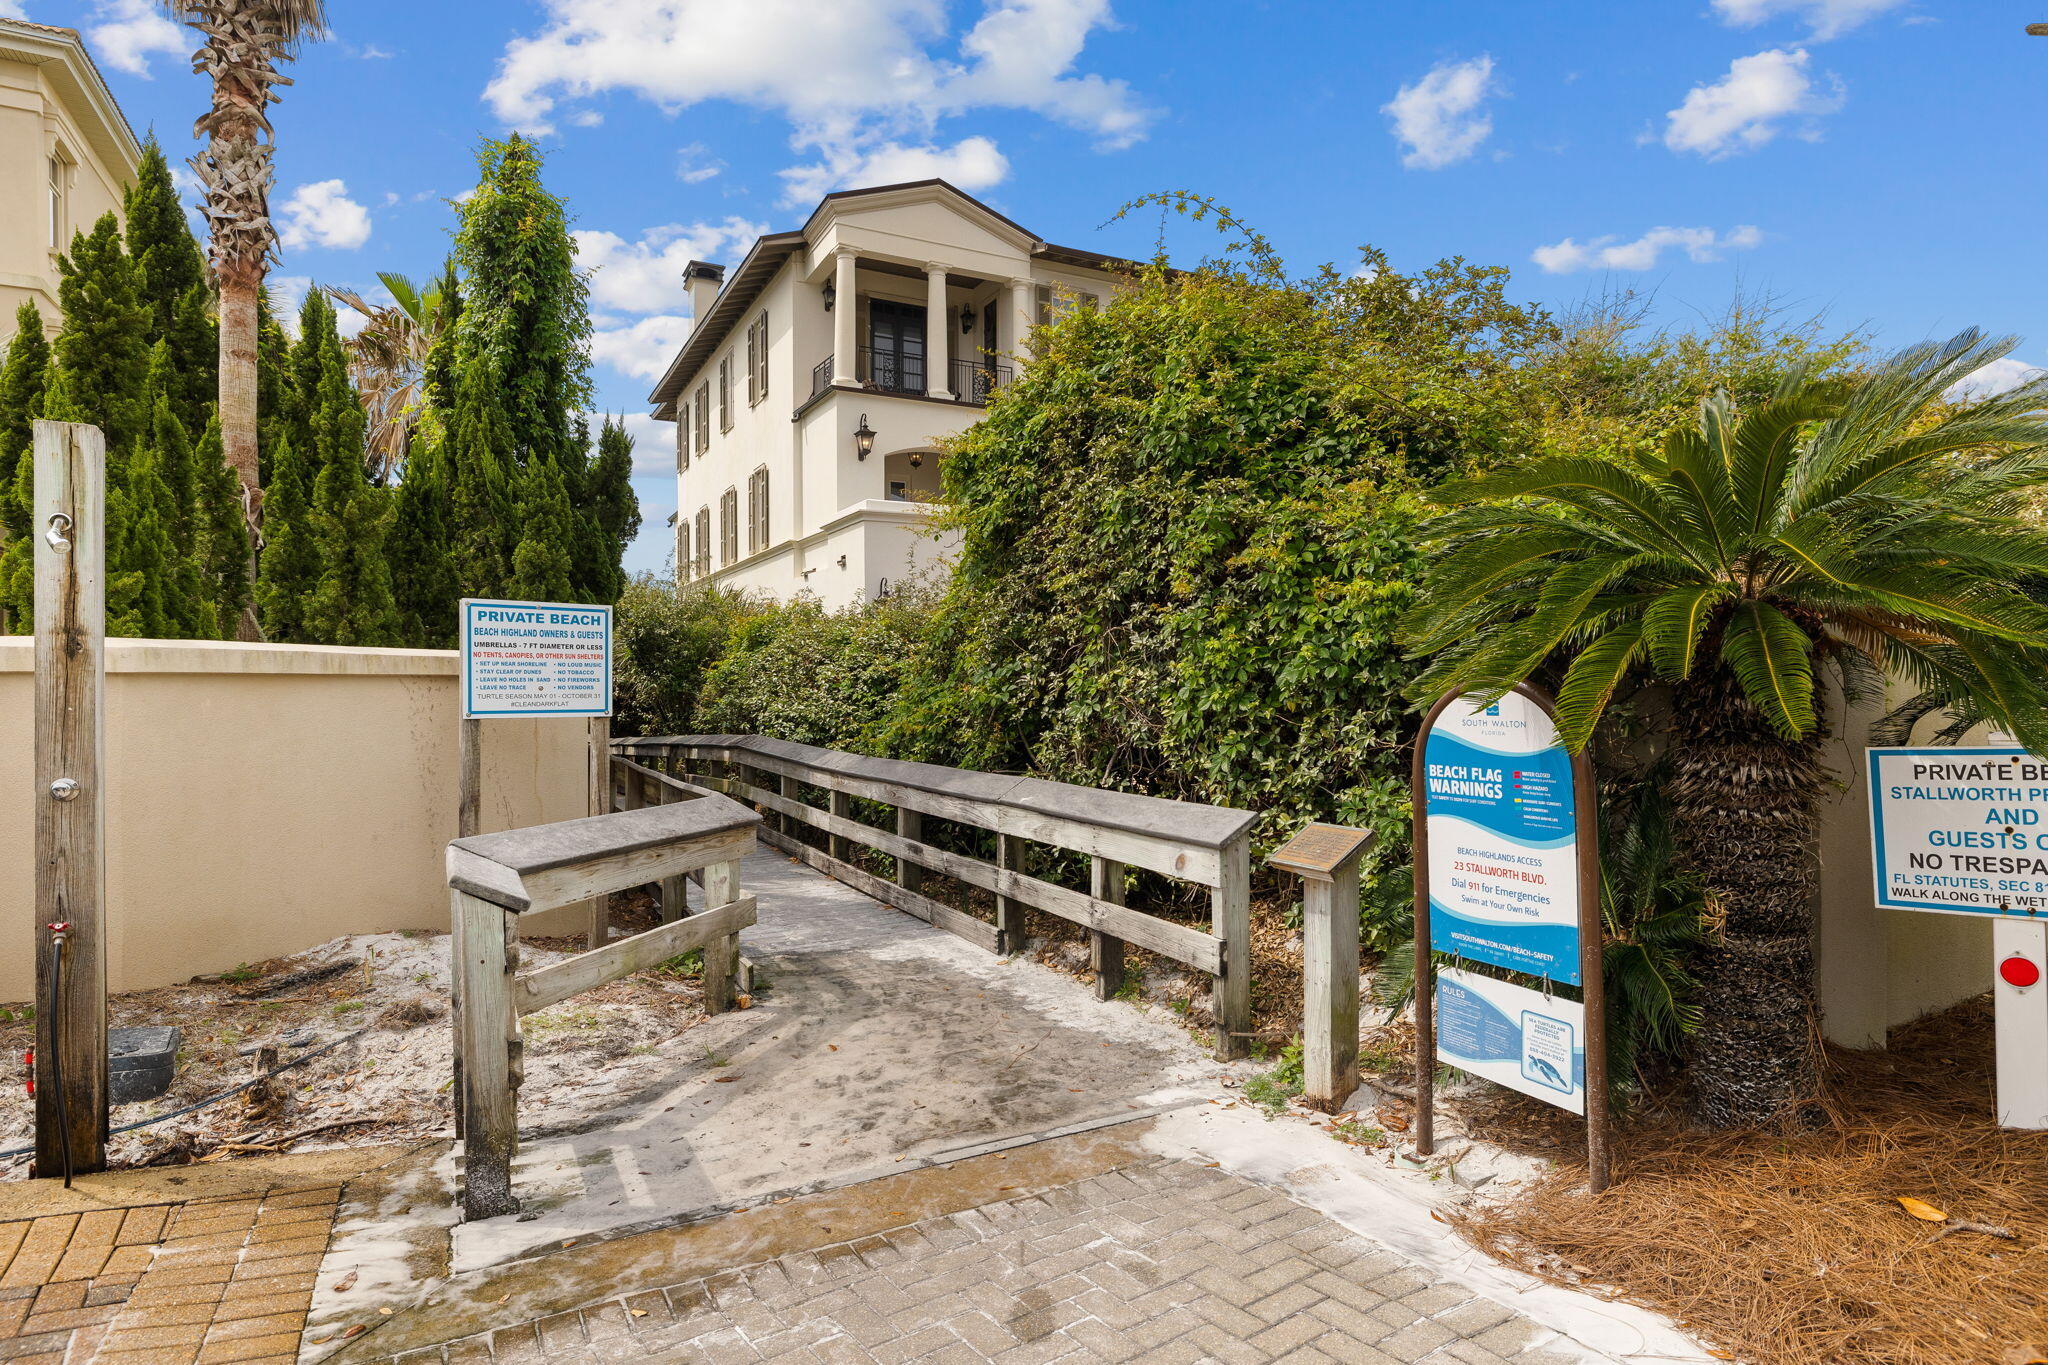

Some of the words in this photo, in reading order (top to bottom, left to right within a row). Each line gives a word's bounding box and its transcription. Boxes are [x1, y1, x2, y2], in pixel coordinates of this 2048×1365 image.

[477, 610, 545, 623] PRIVATE
[550, 614, 601, 626] BEACH
[473, 627, 499, 636] BEACH
[500, 628, 538, 638] HIGHLAND
[539, 629, 569, 639] OWNERS
[570, 630, 575, 639] &
[577, 631, 604, 639] GUESTS
[473, 641, 518, 649] UMBRELLAS
[1461, 719, 1488, 727] SOUTH
[1491, 720, 1527, 728] WALTON
[1429, 764, 1468, 780] BEACH
[1471, 767, 1503, 782] FLAG
[1913, 764, 2014, 781] PRIVATE
[1429, 778, 1503, 799] WARNINGS
[1890, 786, 2022, 801] STALLWORTH
[1985, 808, 2039, 826] AND
[1928, 830, 2028, 850] GUESTS
[1457, 846, 1478, 857] BEACH
[1478, 850, 1516, 863] HIGHLANDS
[1516, 856, 1543, 867] ACCESS
[1909, 852, 1943, 870] NO
[1454, 861, 1464, 871] 23
[1465, 862, 1519, 880] STALLWORTH
[1521, 871, 1547, 886] BLVD.
[1894, 873, 1911, 884] FL
[1914, 874, 1994, 892] STATUTES,
[1998, 879, 2030, 892] SEC
[1451, 877, 1467, 889] Dial
[1468, 881, 1480, 892] 911
[1481, 882, 1493, 894] for
[1495, 885, 1551, 905] Emergencies
[1891, 887, 1929, 899] WALK
[1932, 890, 1980, 903] ALONG
[1983, 893, 2011, 905] THE
[2014, 895, 2048, 908] WET
[1461, 894, 1480, 905] Swim
[1480, 899, 1488, 907] at
[1489, 900, 1505, 911] Your
[1506, 903, 1523, 914] Own
[1524, 906, 1540, 918] Risk
[1442, 985, 1465, 999] RULES
